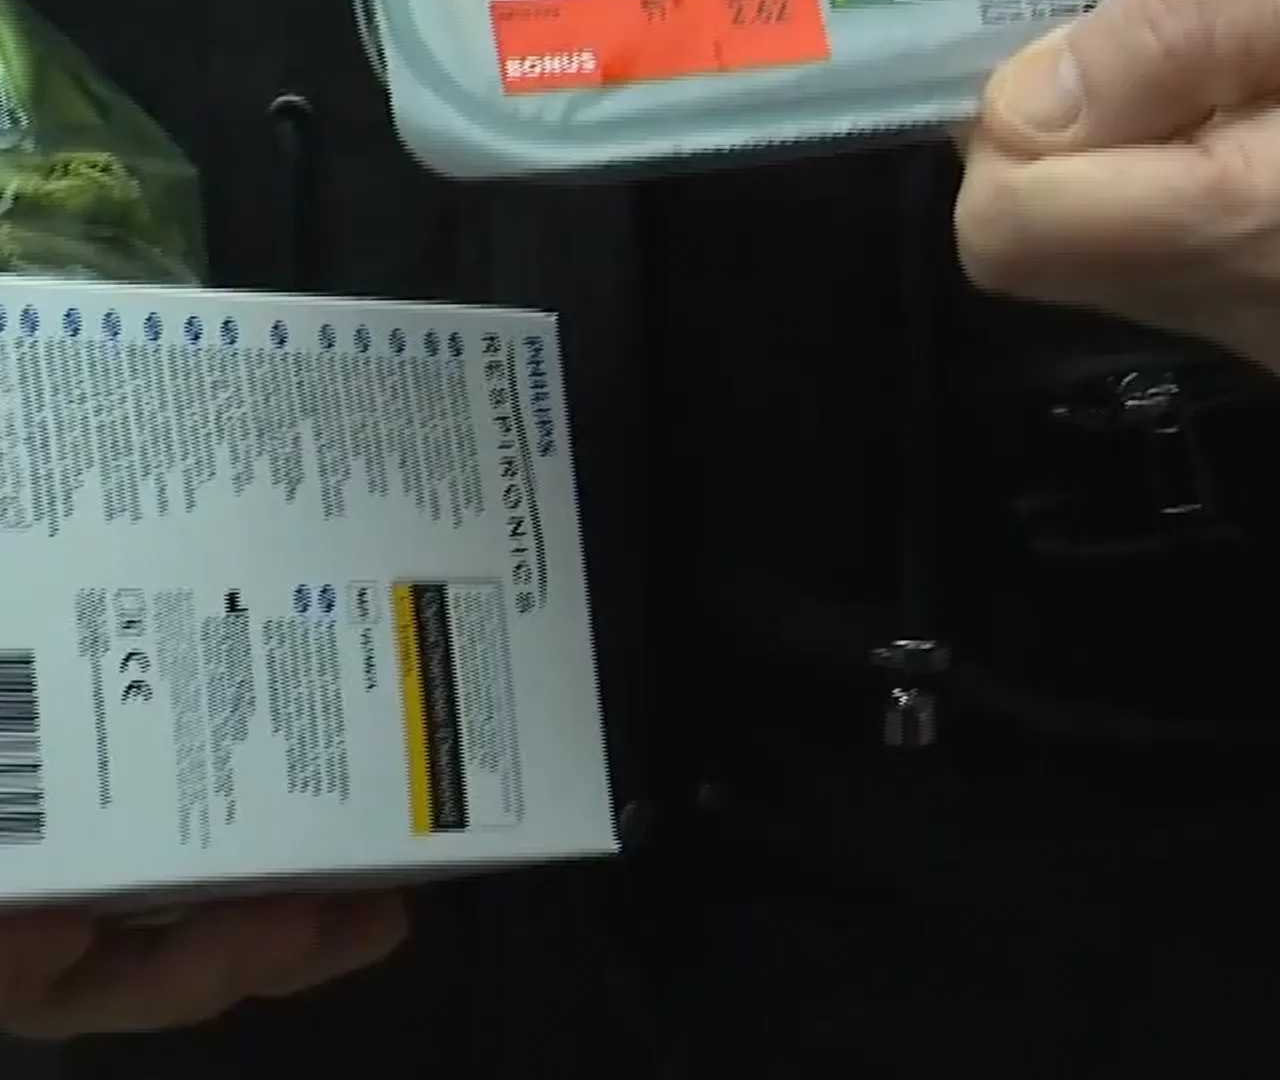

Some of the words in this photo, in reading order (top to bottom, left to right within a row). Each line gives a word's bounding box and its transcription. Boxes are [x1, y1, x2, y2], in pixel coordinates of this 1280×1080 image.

[504, 49, 597, 80] BONUS
[524, 334, 556, 456] PHILIPS
[482, 333, 535, 613] RESPIRONICS
